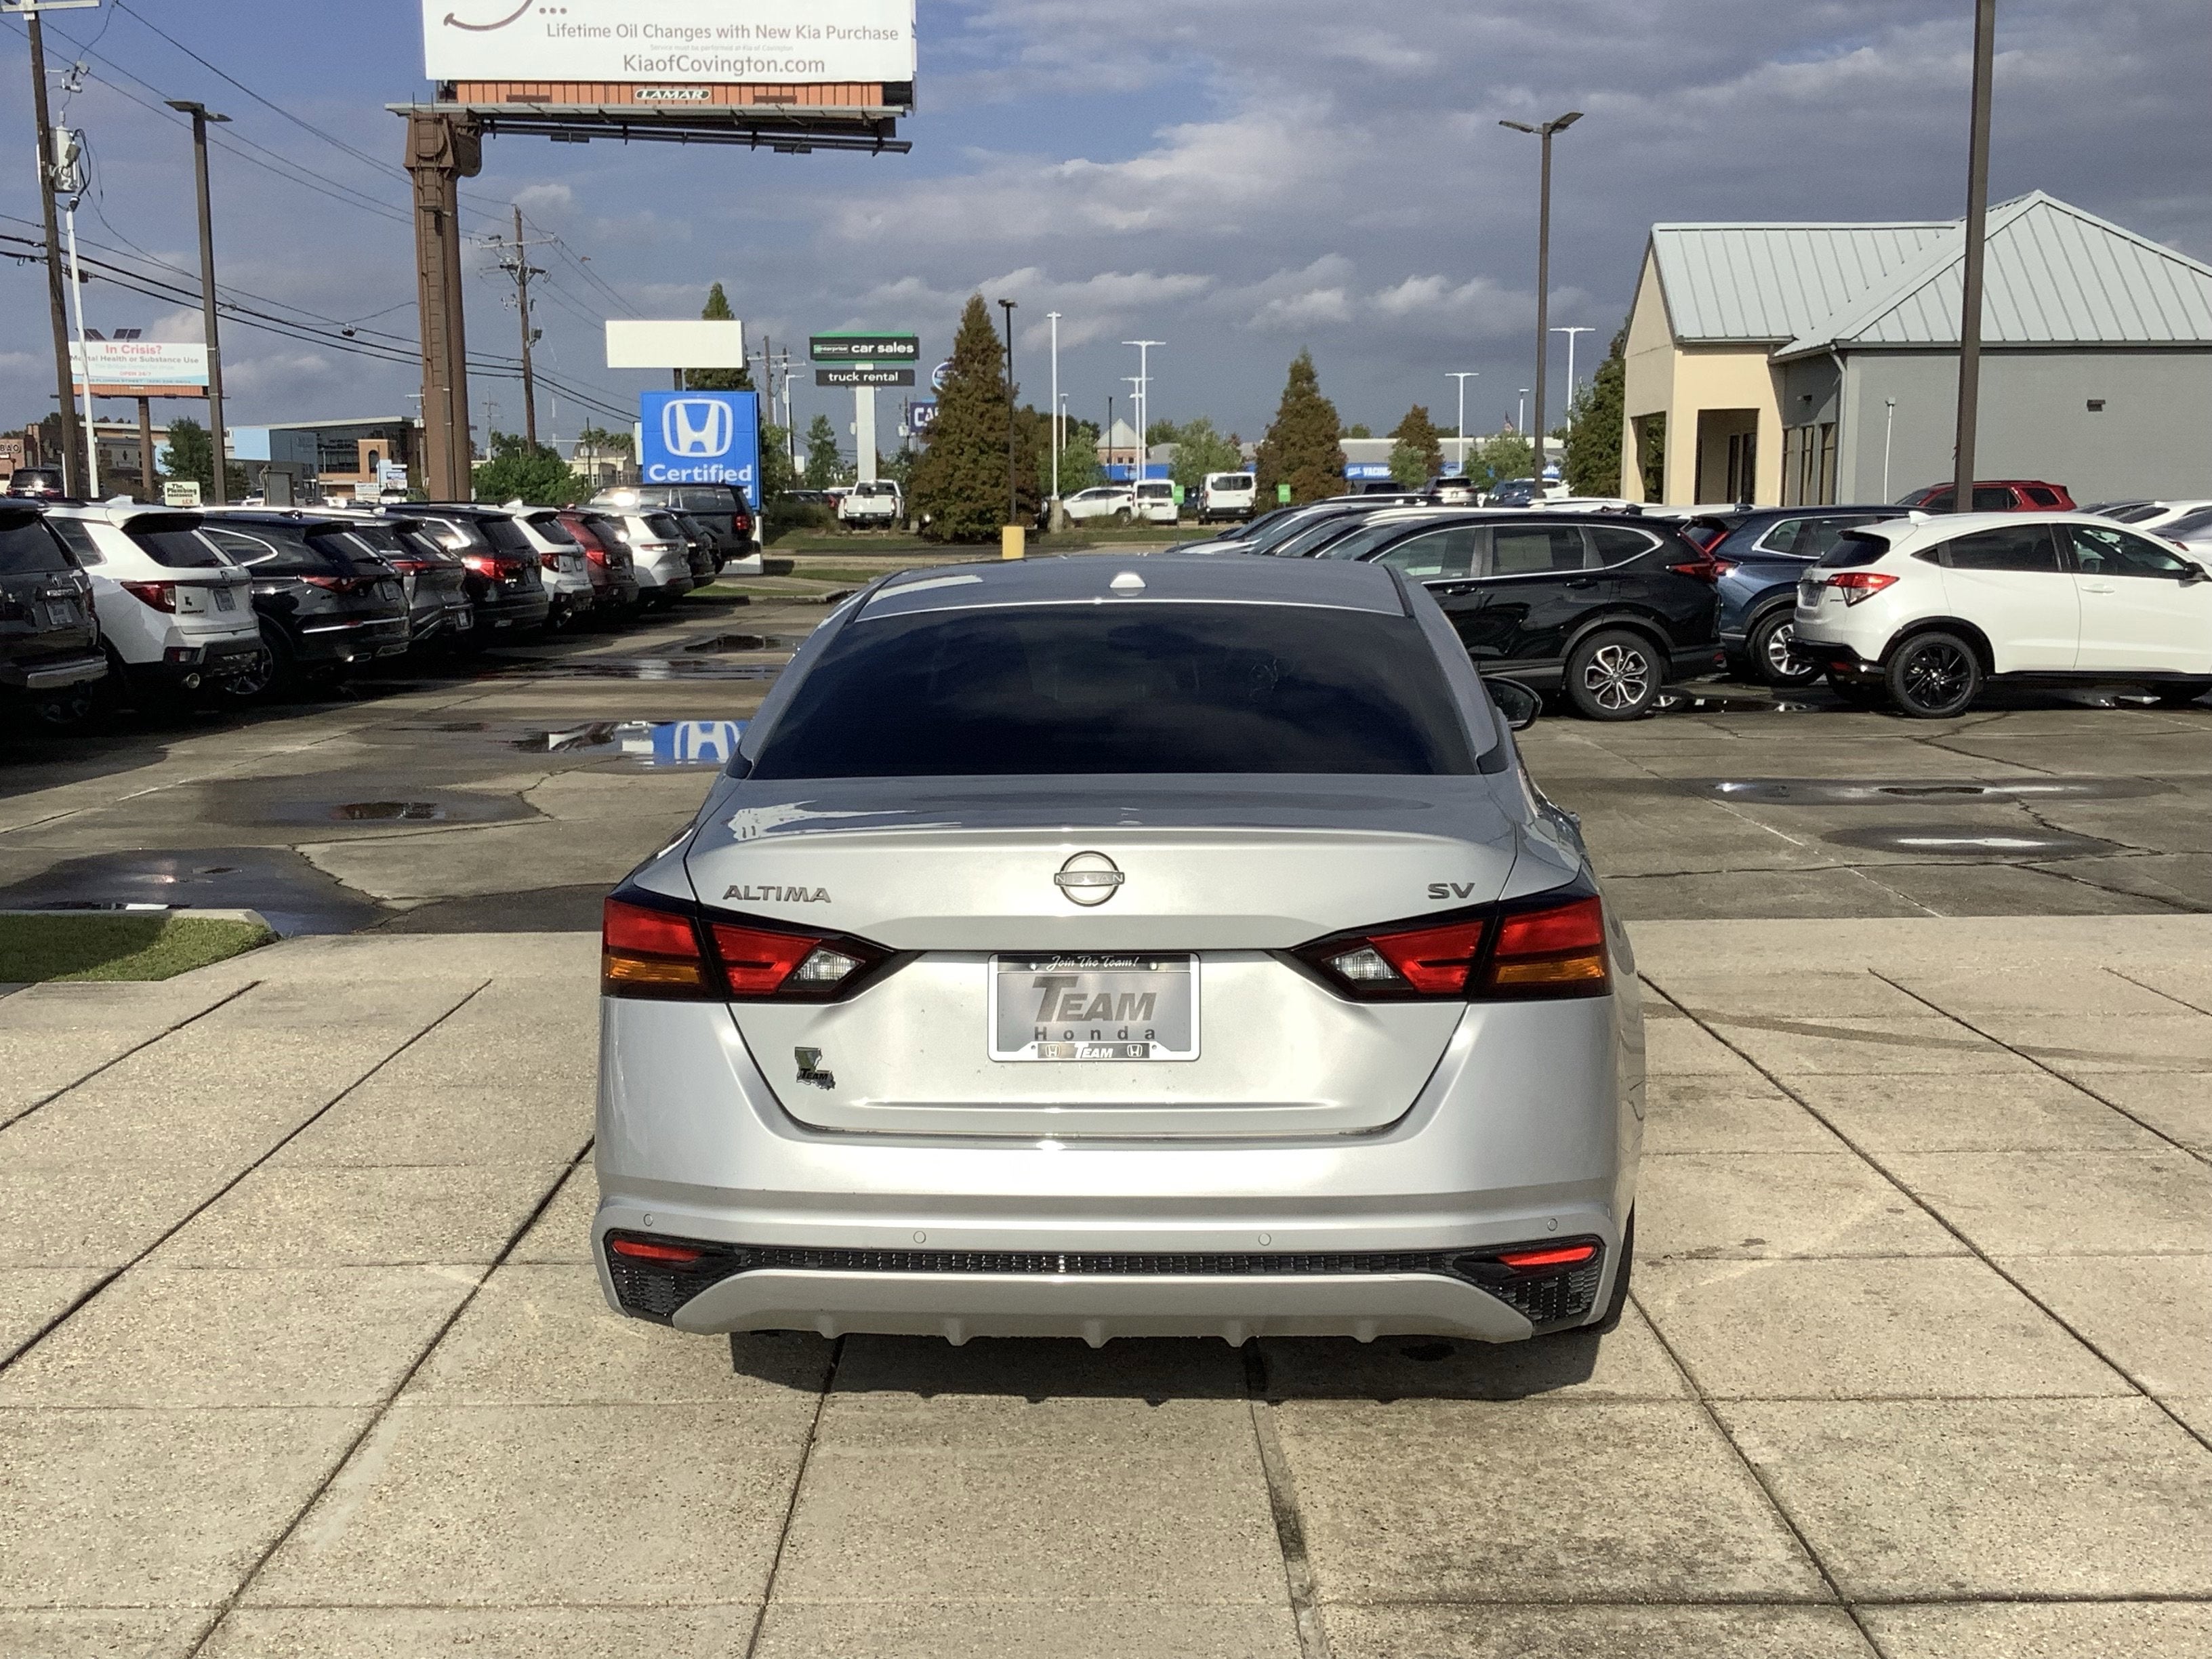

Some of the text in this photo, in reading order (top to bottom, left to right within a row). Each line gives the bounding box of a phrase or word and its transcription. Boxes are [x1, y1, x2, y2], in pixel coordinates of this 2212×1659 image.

[546, 23, 899, 42] Lifetime Oil Changes with New Kia Purchase
[623, 54, 825, 77] KiaofCovington.com
[640, 90, 703, 100] LAMAR
[105, 344, 163, 355] In Crisis?
[851, 344, 874, 354] car
[877, 342, 915, 354] sales
[139, 355, 182, 363] Substance
[827, 371, 899, 382] truck rental
[914, 407, 939, 427] CA
[649, 463, 752, 483] Certified
[722, 884, 832, 903] ALTIMA
[1427, 882, 1475, 899] SV
[1046, 955, 1140, 972] Join The Team!
[1031, 975, 1157, 1023] TEAM
[1033, 1025, 1156, 1041] Honda
[1073, 1042, 1114, 1059] TEAM
[800, 1067, 829, 1080] TEAM
